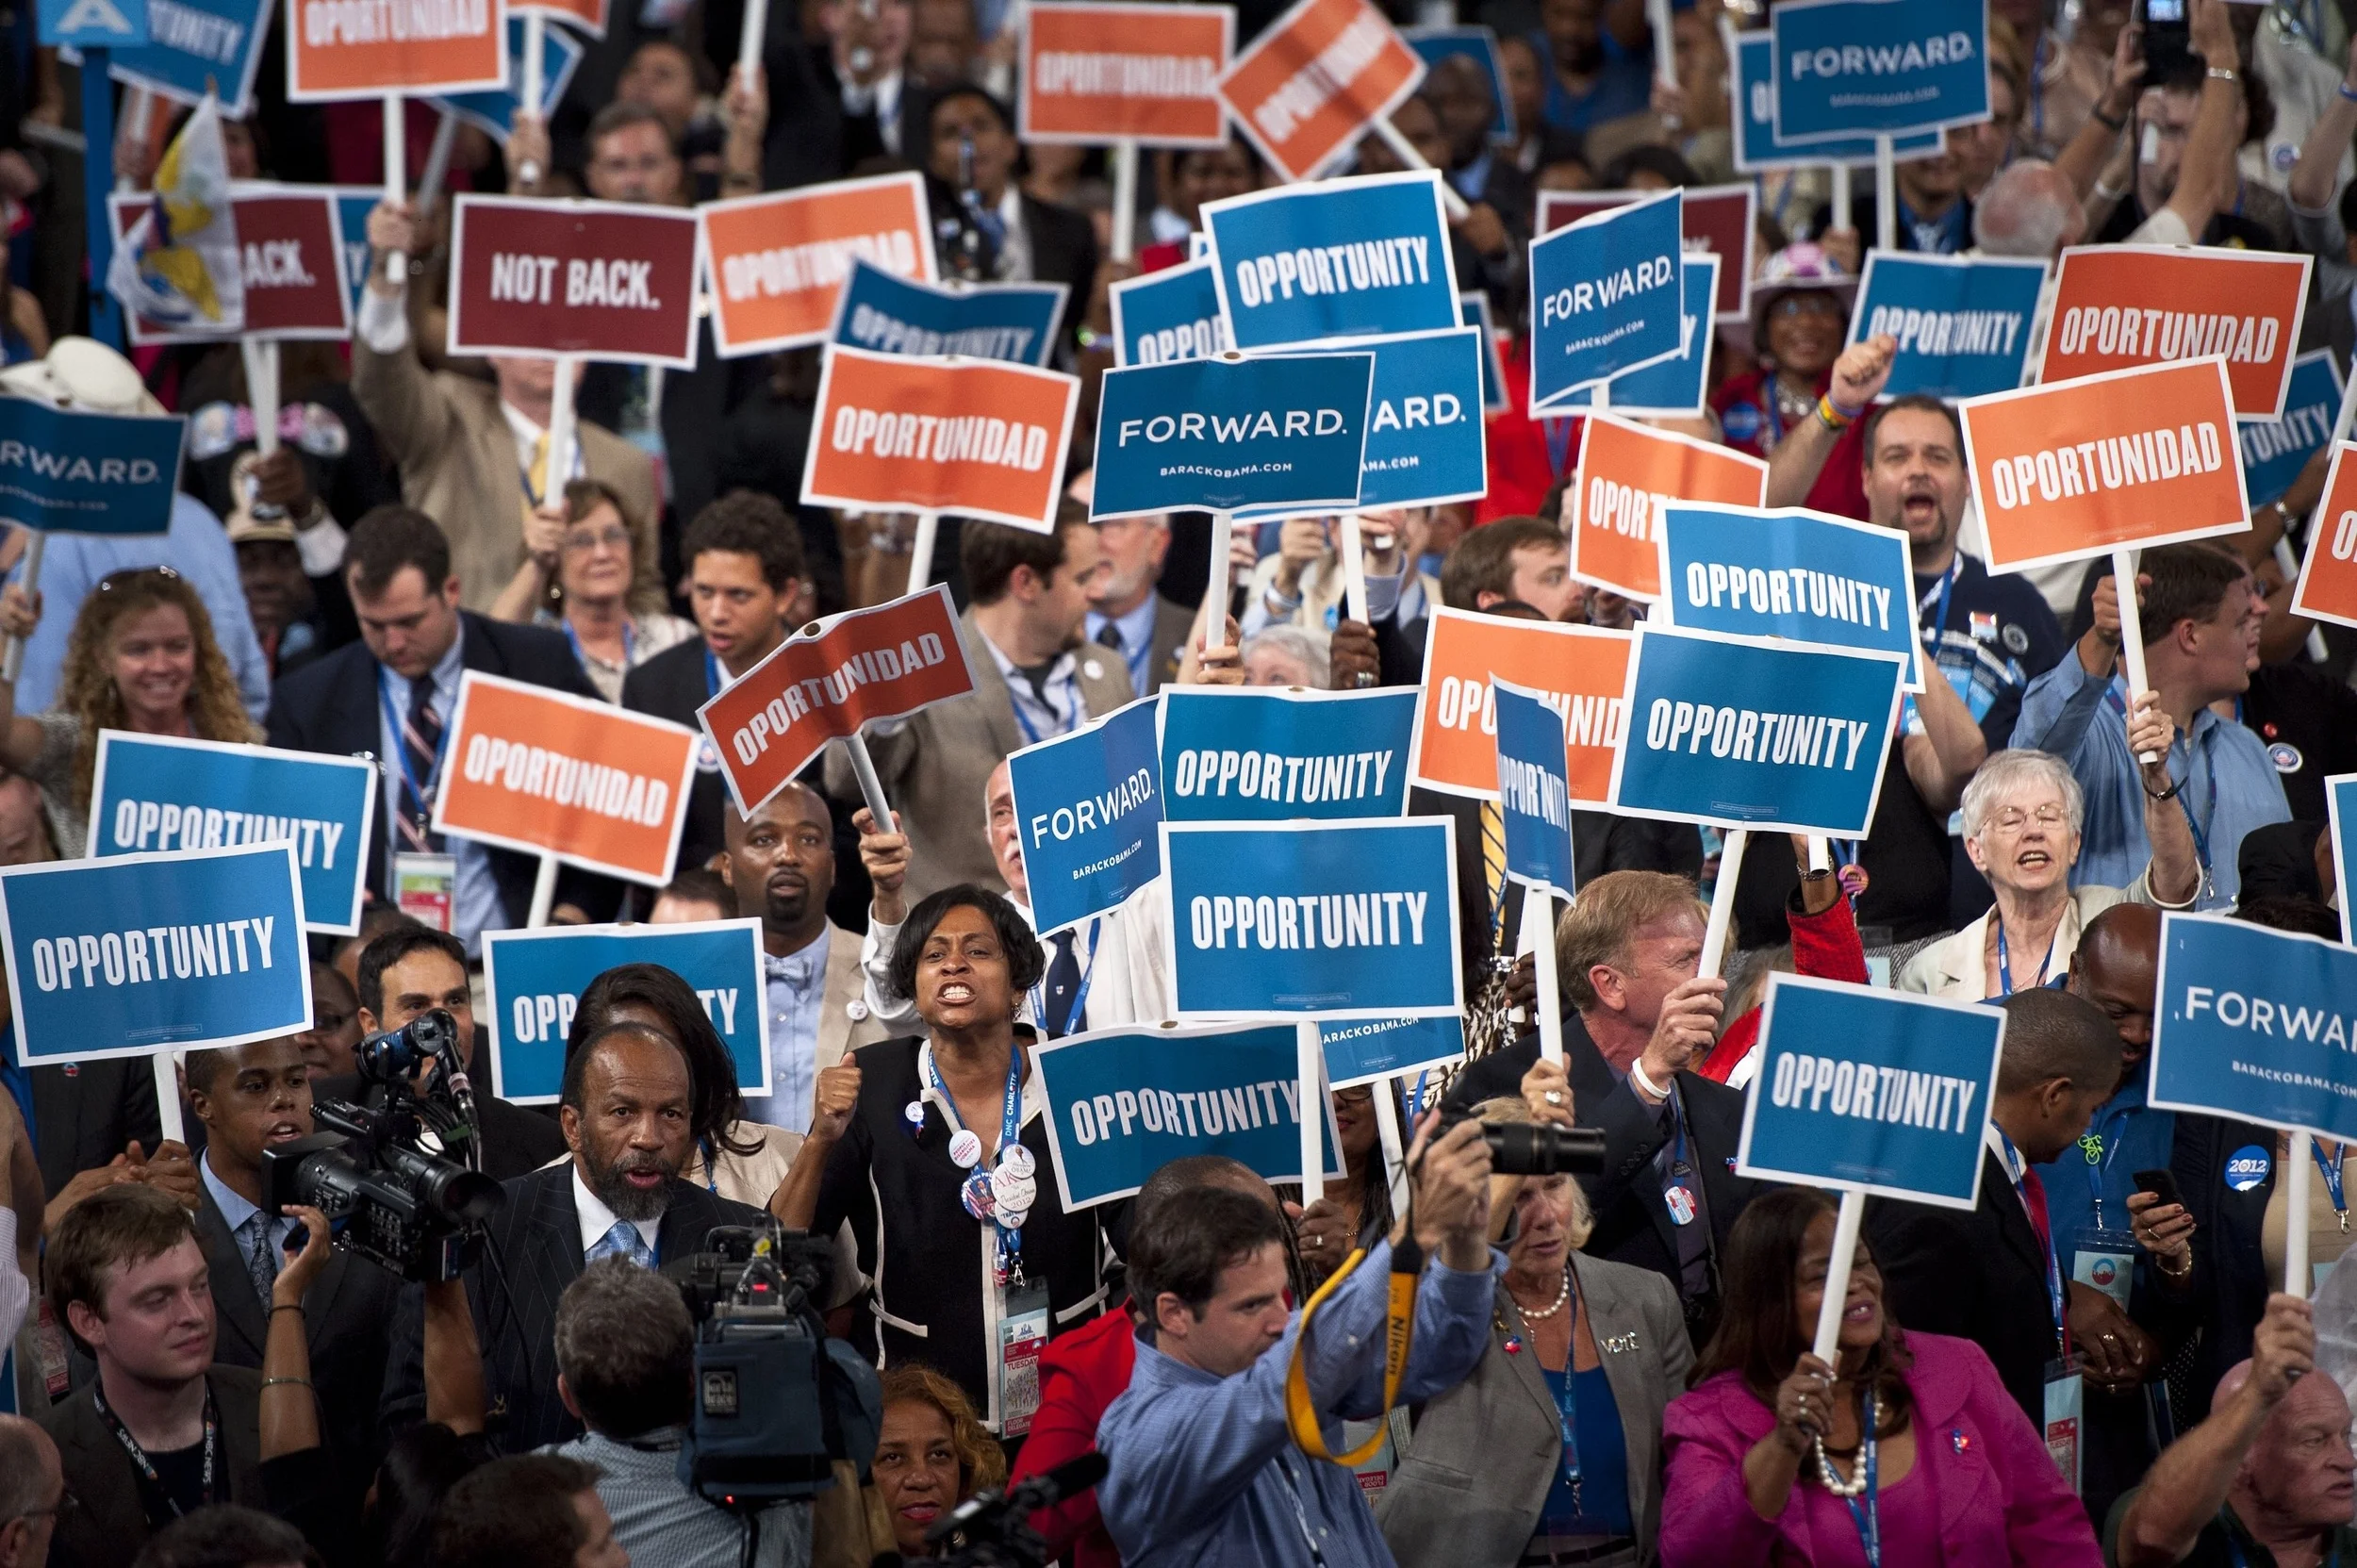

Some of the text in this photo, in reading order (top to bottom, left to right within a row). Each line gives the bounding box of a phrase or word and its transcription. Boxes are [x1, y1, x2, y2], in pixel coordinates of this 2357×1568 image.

[490, 252, 662, 311] NOT BACK.
[1235, 236, 1430, 308] OPPORTUNITY
[1542, 256, 1675, 328] FORWARD.
[2059, 305, 2281, 365] OPORTUNIDAD
[832, 405, 1048, 471] OPORTUNIDAD
[1118, 408, 1348, 448] FORWARD.
[1160, 462, 1293, 478] BARACKOBAMA.COM
[1991, 421, 2223, 510] OPORTUNIDAD
[1686, 562, 1891, 632] OPPORTUNITY
[733, 631, 947, 767] OPORTUNIDAD
[1646, 698, 1869, 771] OPPORTUNITY
[464, 734, 670, 828] OPORTUNIDAD
[1174, 749, 1393, 803] OPPORTUNITY
[1031, 767, 1156, 850] FORWARD.
[1072, 838, 1143, 881] BARACKOBAMA.COM
[1190, 890, 1429, 950] OPPORTUNITY
[32, 916, 275, 993] OPPORTUNITY
[2185, 985, 2357, 1055] FORWA
[1772, 1050, 1977, 1134] OPPORTUNITY
[1004, 1119, 1014, 1137] DNC
[2228, 1159, 2267, 1173] 2012
[1007, 1357, 1038, 1372] TUESDAY
[1389, 1315, 1406, 1377] Nikon
[1600, 1331, 1640, 1355] VOTE
[202, 1436, 213, 1484] NBC NEWS
